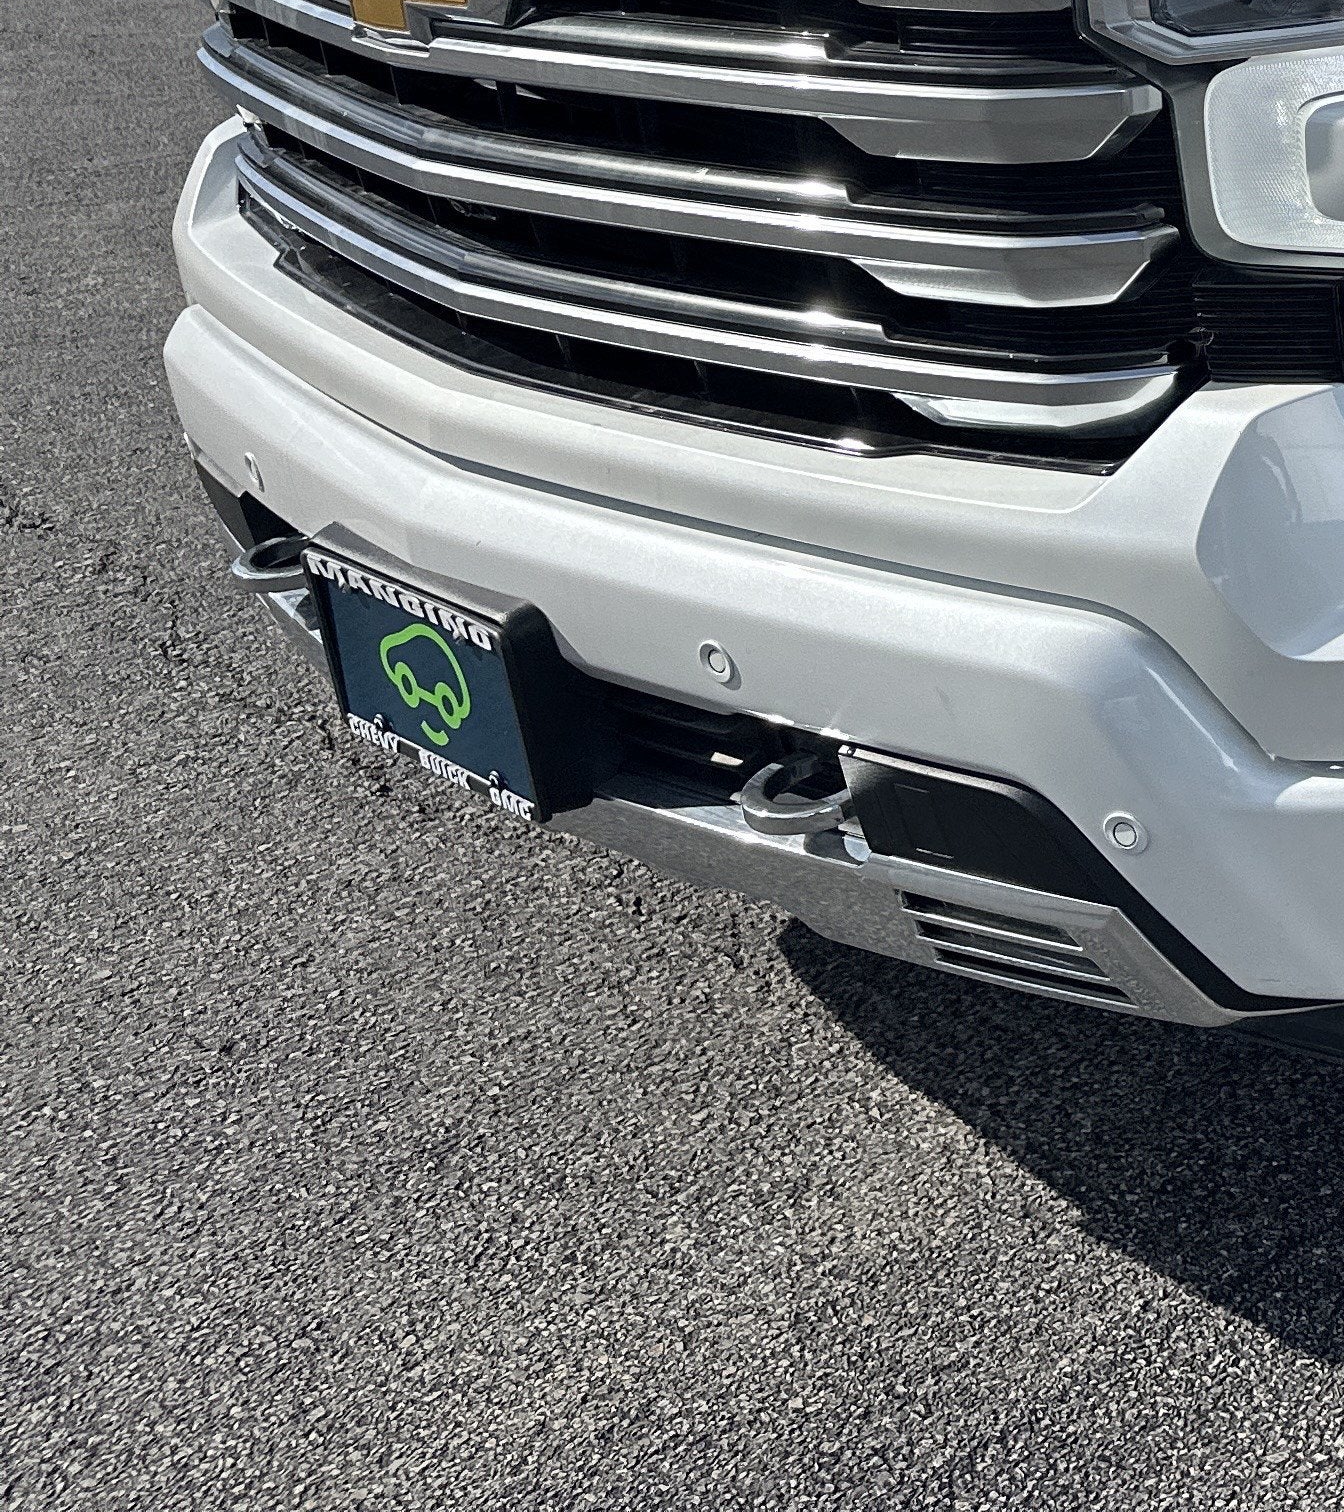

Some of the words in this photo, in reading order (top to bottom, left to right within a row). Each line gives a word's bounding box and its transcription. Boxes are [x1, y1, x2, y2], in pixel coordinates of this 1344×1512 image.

[307, 555, 492, 650] MANGINO
[348, 717, 400, 753] CHEVY
[418, 748, 471, 790] BUICK
[489, 786, 535, 822] GMC
